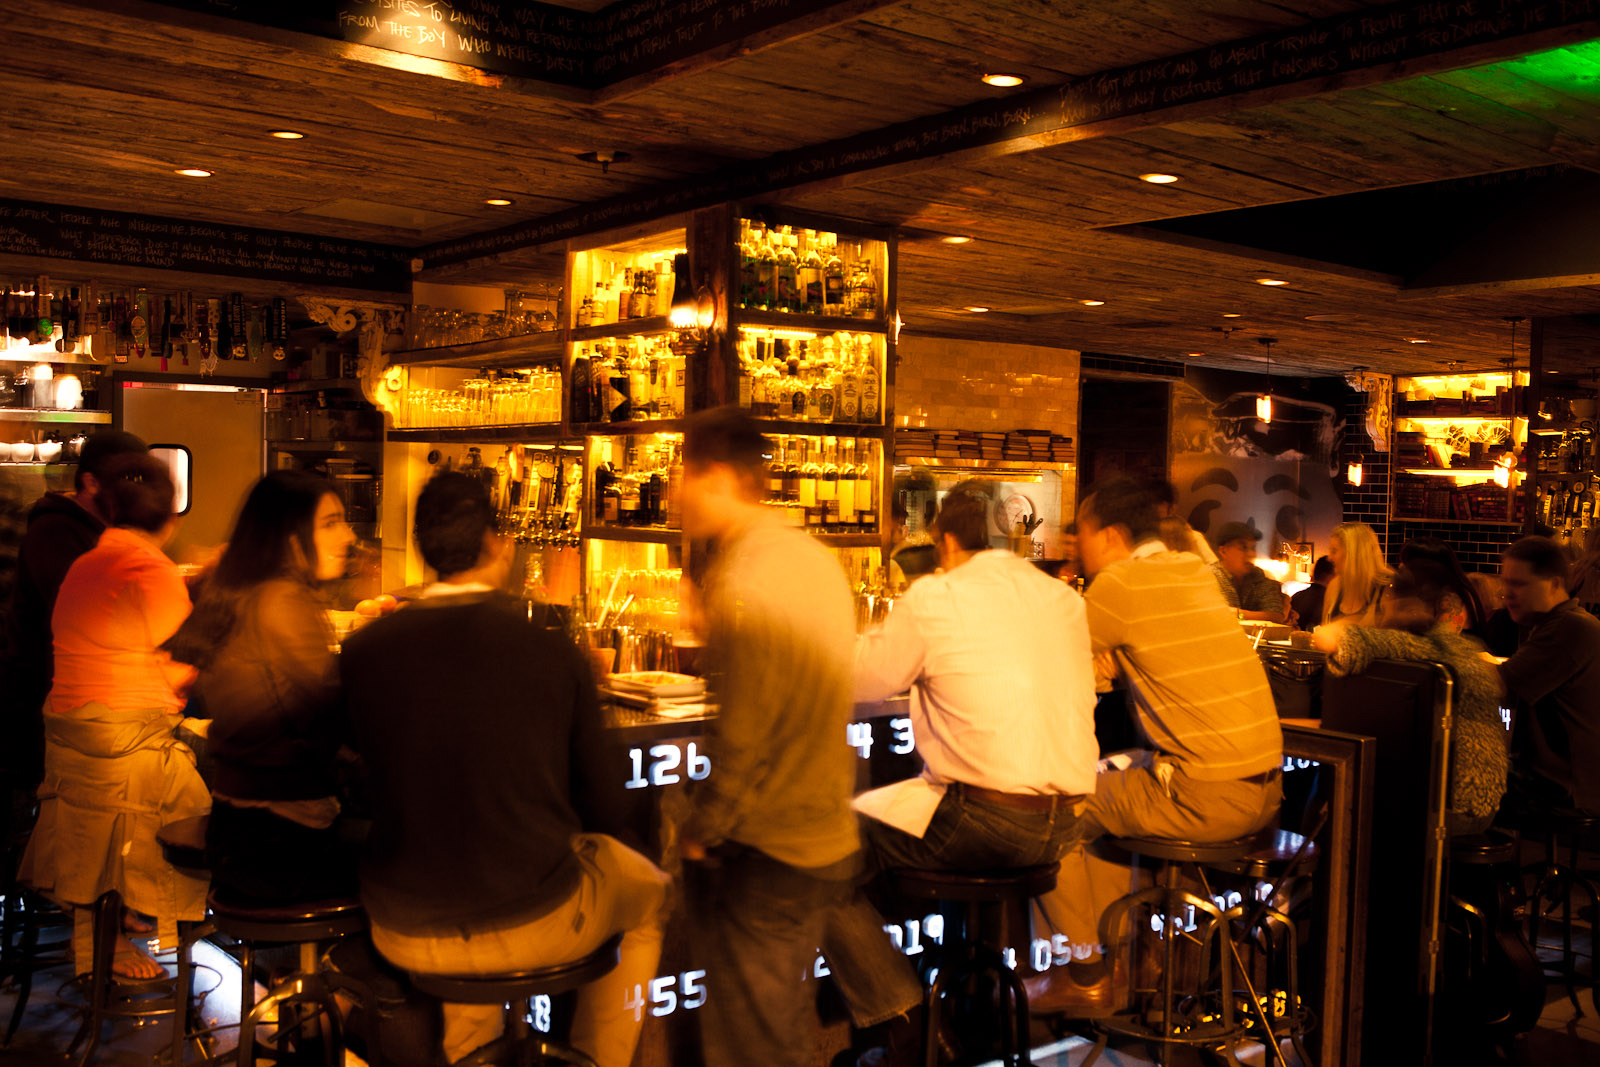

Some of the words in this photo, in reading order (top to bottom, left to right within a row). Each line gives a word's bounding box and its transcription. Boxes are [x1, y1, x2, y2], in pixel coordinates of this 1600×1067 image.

[338, 10, 381, 33] FROM
[383, 20, 413, 39] THE
[416, 25, 446, 49] BOY
[458, 34, 491, 54] WHO
[423, 2, 443, 22] TO
[450, 9, 490, 34] LIVING
[1172, 58, 1199, 80] AND
[624, 742, 712, 790] 126
[623, 968, 708, 1023] 455
